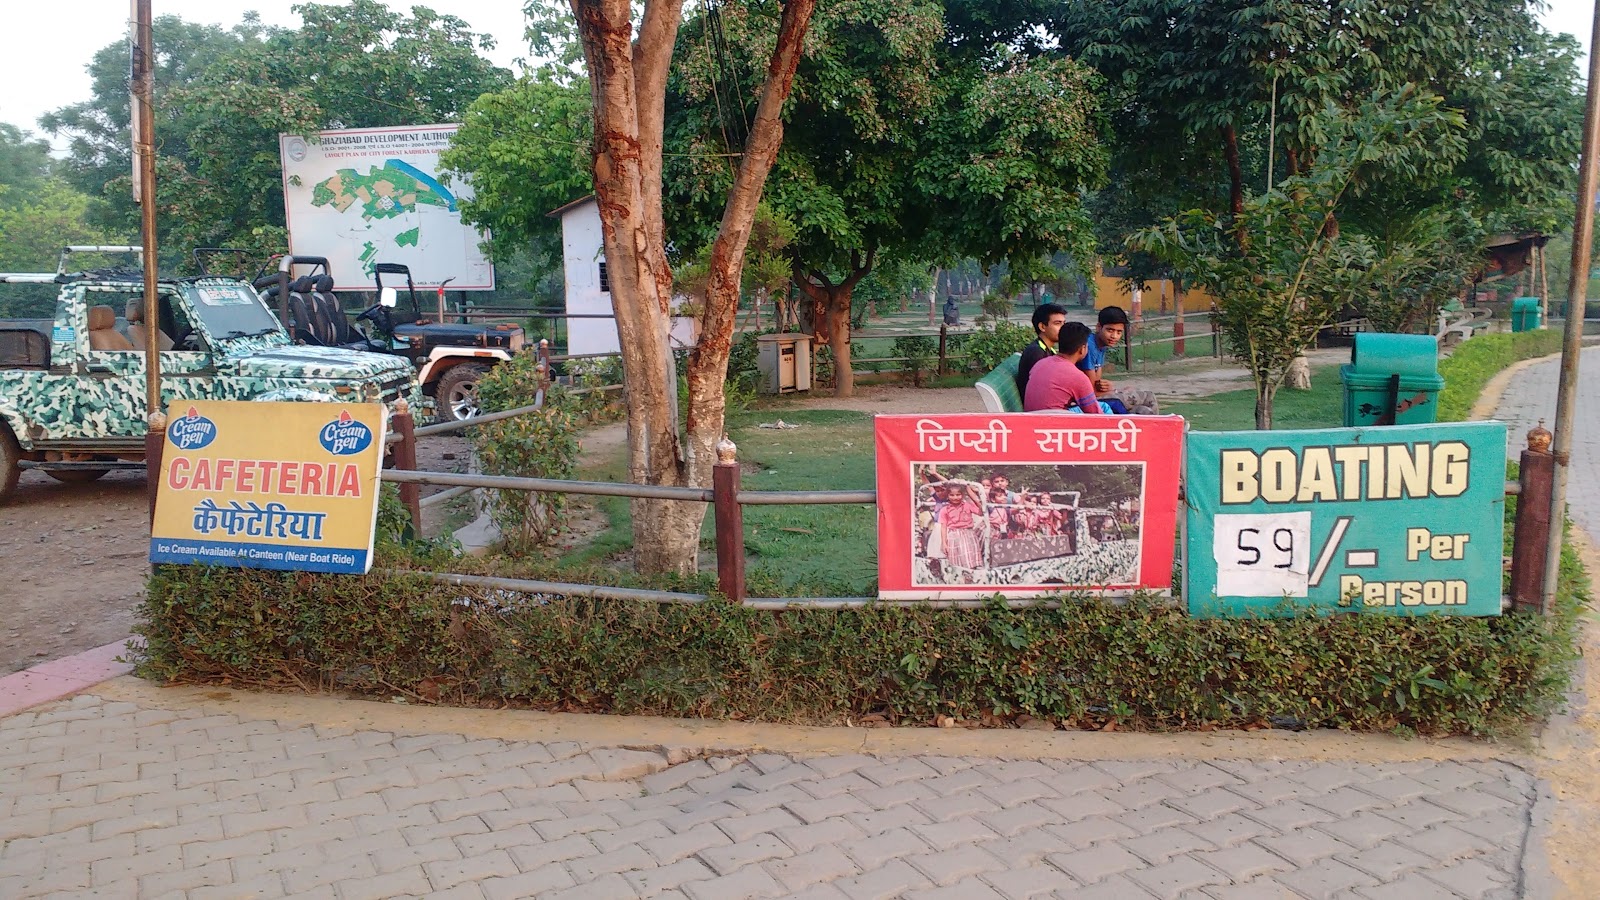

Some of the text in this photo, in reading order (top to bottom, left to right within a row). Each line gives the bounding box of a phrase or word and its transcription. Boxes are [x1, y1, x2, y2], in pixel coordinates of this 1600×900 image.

[320, 136, 362, 145] GHAZIABAD
[364, 133, 419, 143] DEVELOPMENT
[173, 420, 212, 438] Cream
[179, 432, 203, 450] Bell
[324, 424, 366, 442] Cream
[915, 419, 1142, 453] जिप्सी सफारी
[332, 437, 357, 455] Bell
[168, 457, 362, 497] CAFETERIA
[1219, 440, 1470, 505] BOATING
[192, 499, 327, 541] कैफेटेरिया
[157, 544, 355, 567] Ice Cream Available At Canteen (Near Boat Ride)
[1406, 526, 1470, 562] Per
[1339, 573, 1469, 608] Person
